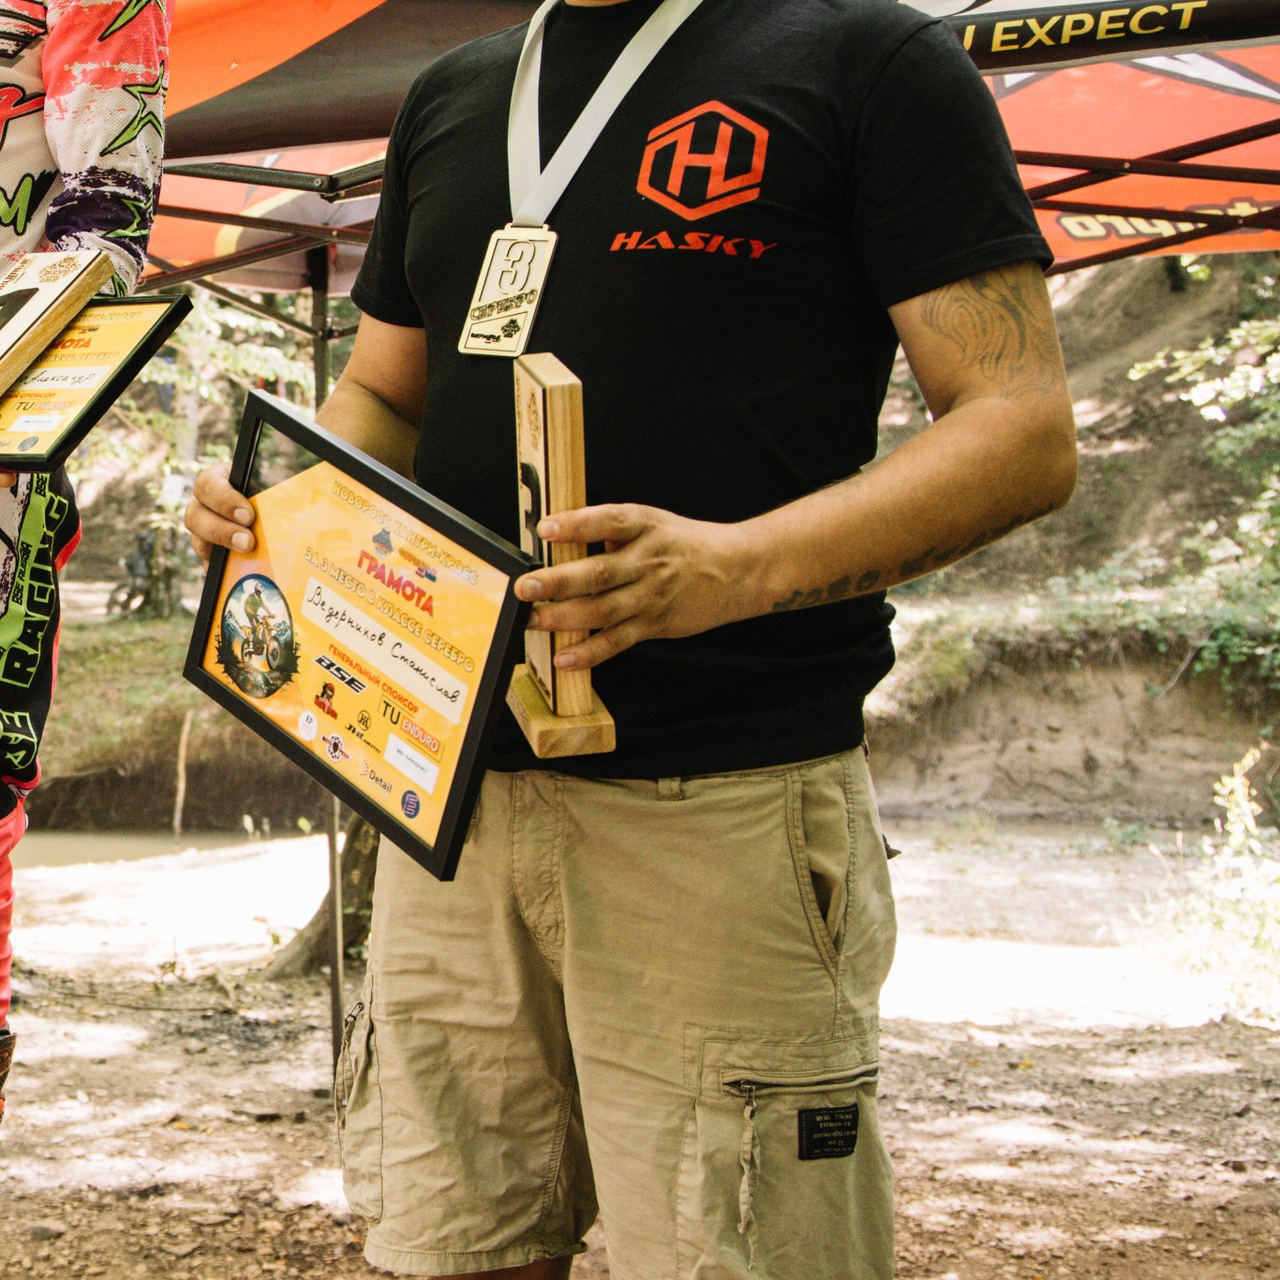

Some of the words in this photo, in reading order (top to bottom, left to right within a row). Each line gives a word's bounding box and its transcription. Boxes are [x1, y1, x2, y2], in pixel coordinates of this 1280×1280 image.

[990, 0, 1209, 53] EXPECT
[498, 239, 536, 296] 3
[609, 230, 778, 259] HASKY
[52, 337, 93, 350] МОТА
[332, 480, 392, 532] НОВОРОСС
[393, 518, 480, 586] КАНТРИ-КРОСС
[17, 540, 32, 581] RUSSIA
[357, 549, 434, 618] ГРАМОТА
[11, 579, 26, 606] BSE
[304, 546, 320, 568] ЗА
[329, 562, 367, 600] МЕСТО
[367, 590, 376, 605] В
[376, 595, 422, 638] КЛАССЕ
[422, 627, 476, 673] СЕРЕБРО
[307, 585, 384, 647] Ведерников
[390, 642, 461, 704] Станислав
[315, 654, 367, 694] BSE
[328, 643, 381, 687] ГЕНЕРАЛЬНЫЙ
[381, 682, 419, 714] СПОНСОР
[382, 700, 401, 726] TU
[401, 719, 440, 753] ENDURO
[368, 769, 393, 794] Detail
